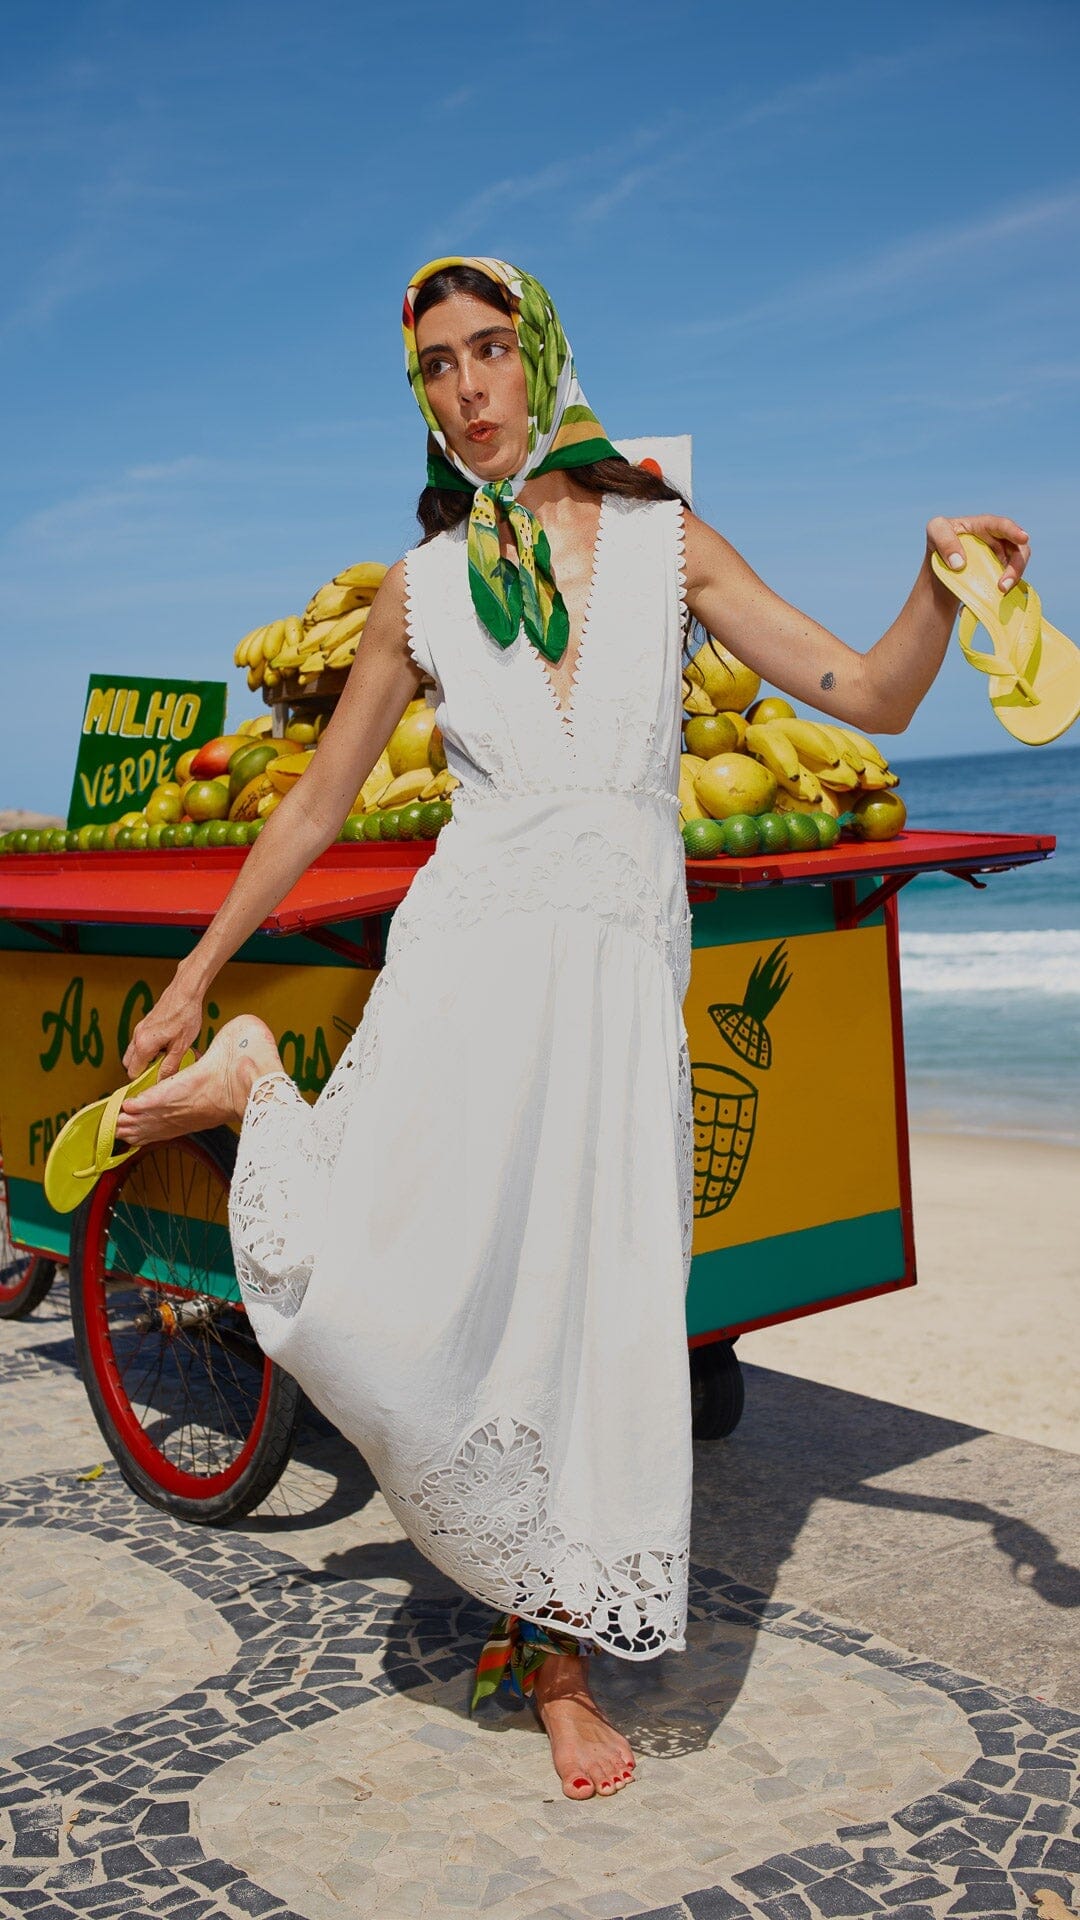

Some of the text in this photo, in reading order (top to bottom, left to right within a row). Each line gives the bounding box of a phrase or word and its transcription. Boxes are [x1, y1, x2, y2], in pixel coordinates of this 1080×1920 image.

[83, 688, 201, 741] MILHO
[80, 743, 174, 808] VERDE
[39, 976, 104, 1072] As
